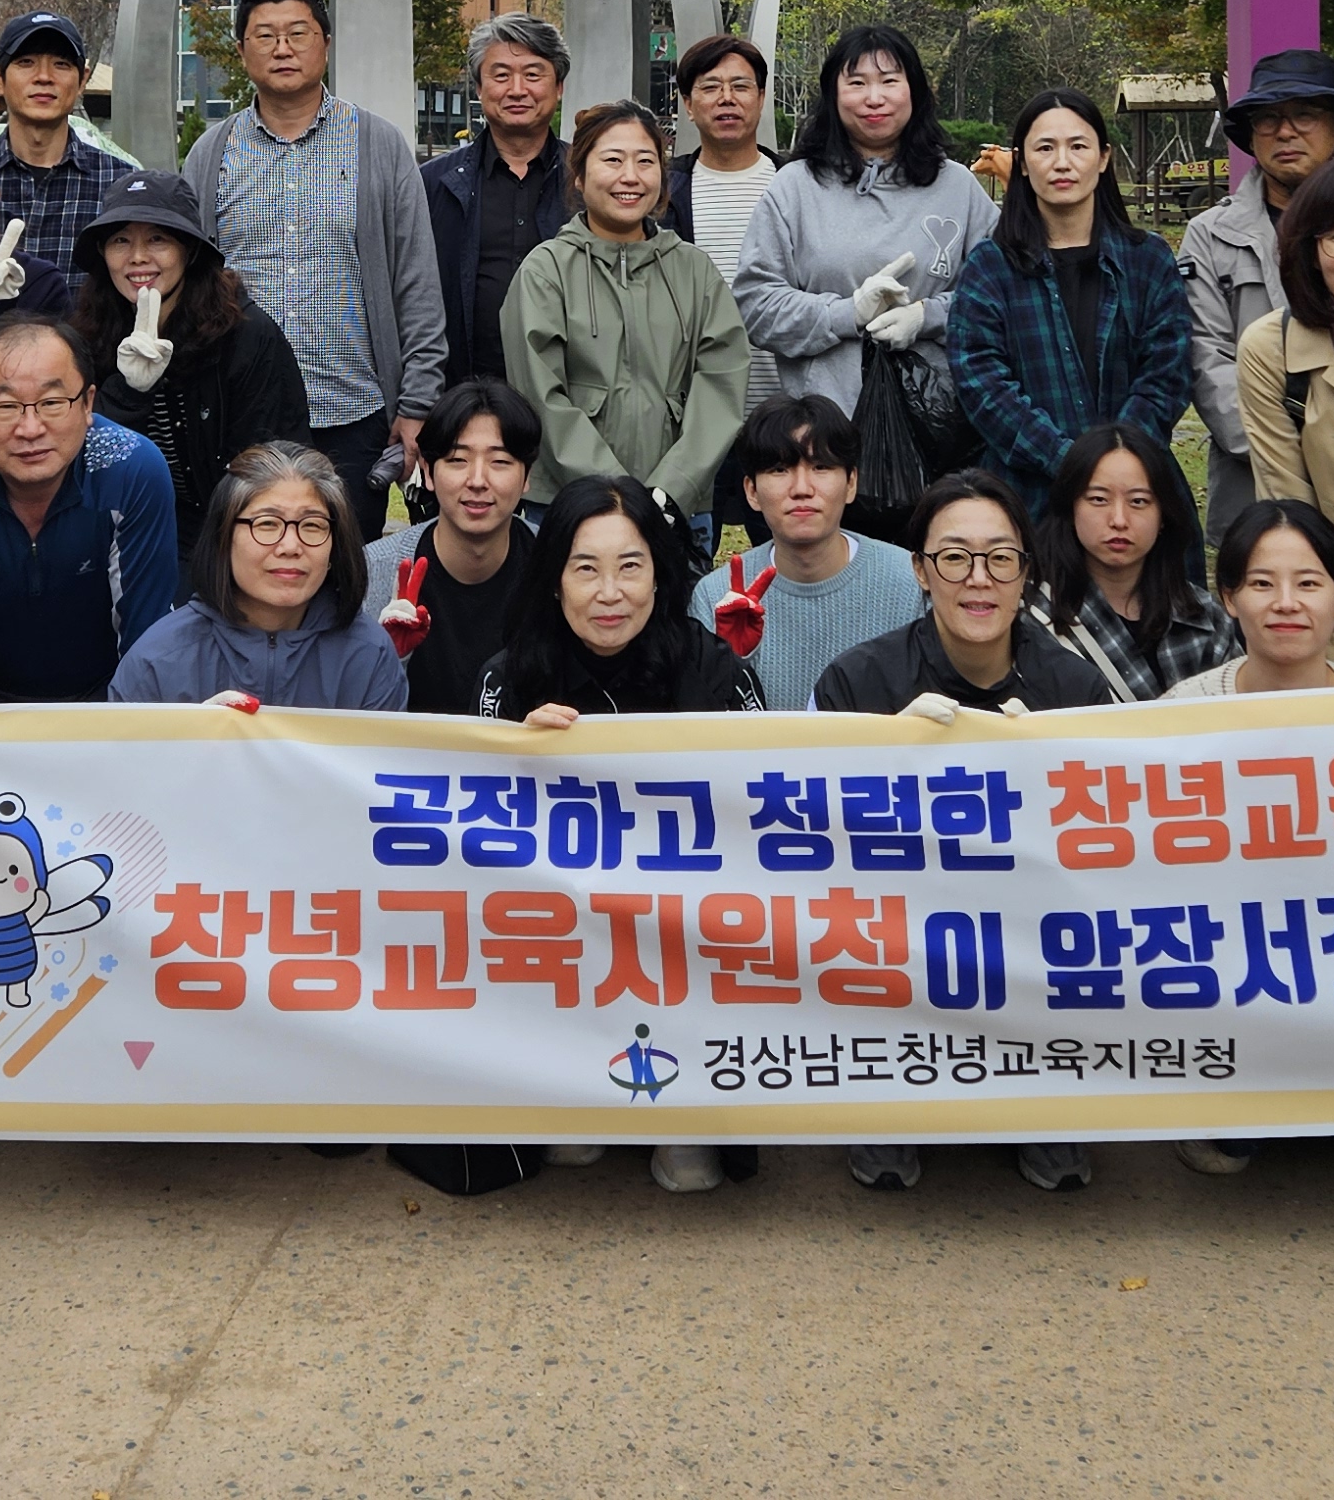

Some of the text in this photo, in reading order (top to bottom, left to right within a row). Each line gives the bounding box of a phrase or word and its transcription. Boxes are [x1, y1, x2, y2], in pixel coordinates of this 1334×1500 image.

[369, 773, 724, 871] 공정하고
[747, 766, 1024, 872] 청렴한
[151, 883, 1007, 1011] 창녕교육지원청이
[705, 1033, 1238, 1092] 경상남도창녕교육지원청
